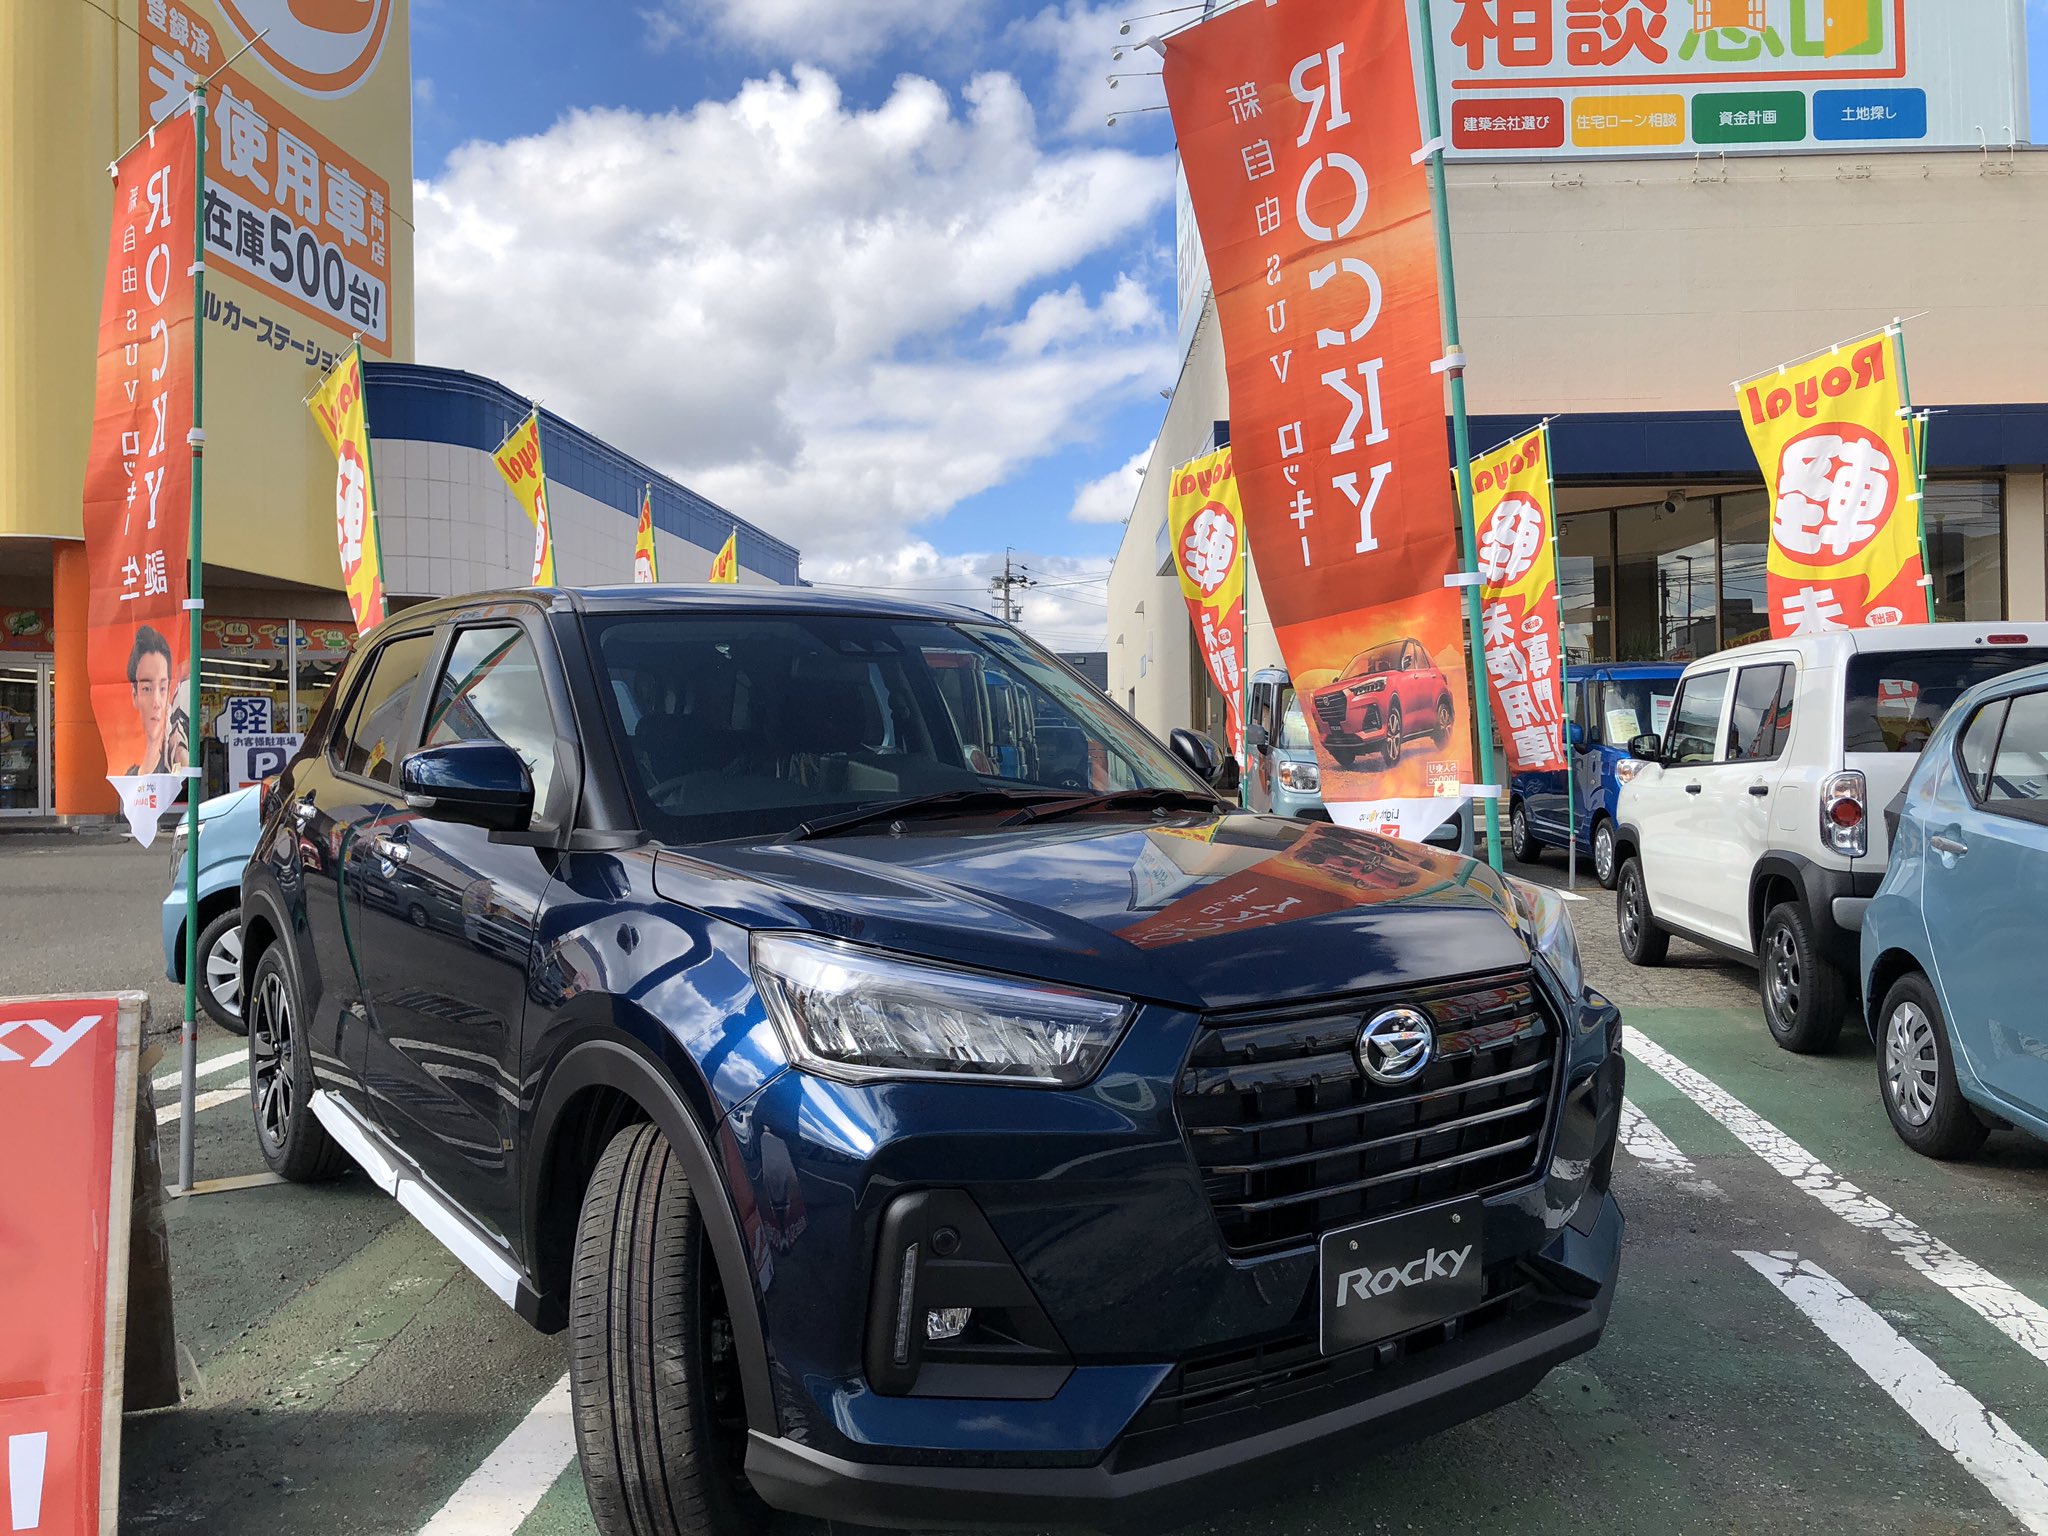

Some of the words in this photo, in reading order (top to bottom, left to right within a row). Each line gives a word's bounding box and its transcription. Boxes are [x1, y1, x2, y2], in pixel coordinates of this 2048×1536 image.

[1575, 112, 1678, 130] 住宅ローン相談
[1718, 109, 1777, 127] 資金計画
[1840, 105, 1898, 122] 土地探し
[1463, 114, 1550, 132] 建築会社選び
[369, 188, 386, 268] 専門店
[230, 698, 268, 734] 軽
[232, 736, 298, 748] お客様駐車場
[254, 751, 280, 780] P
[1336, 1244, 1473, 1308] Rocky
